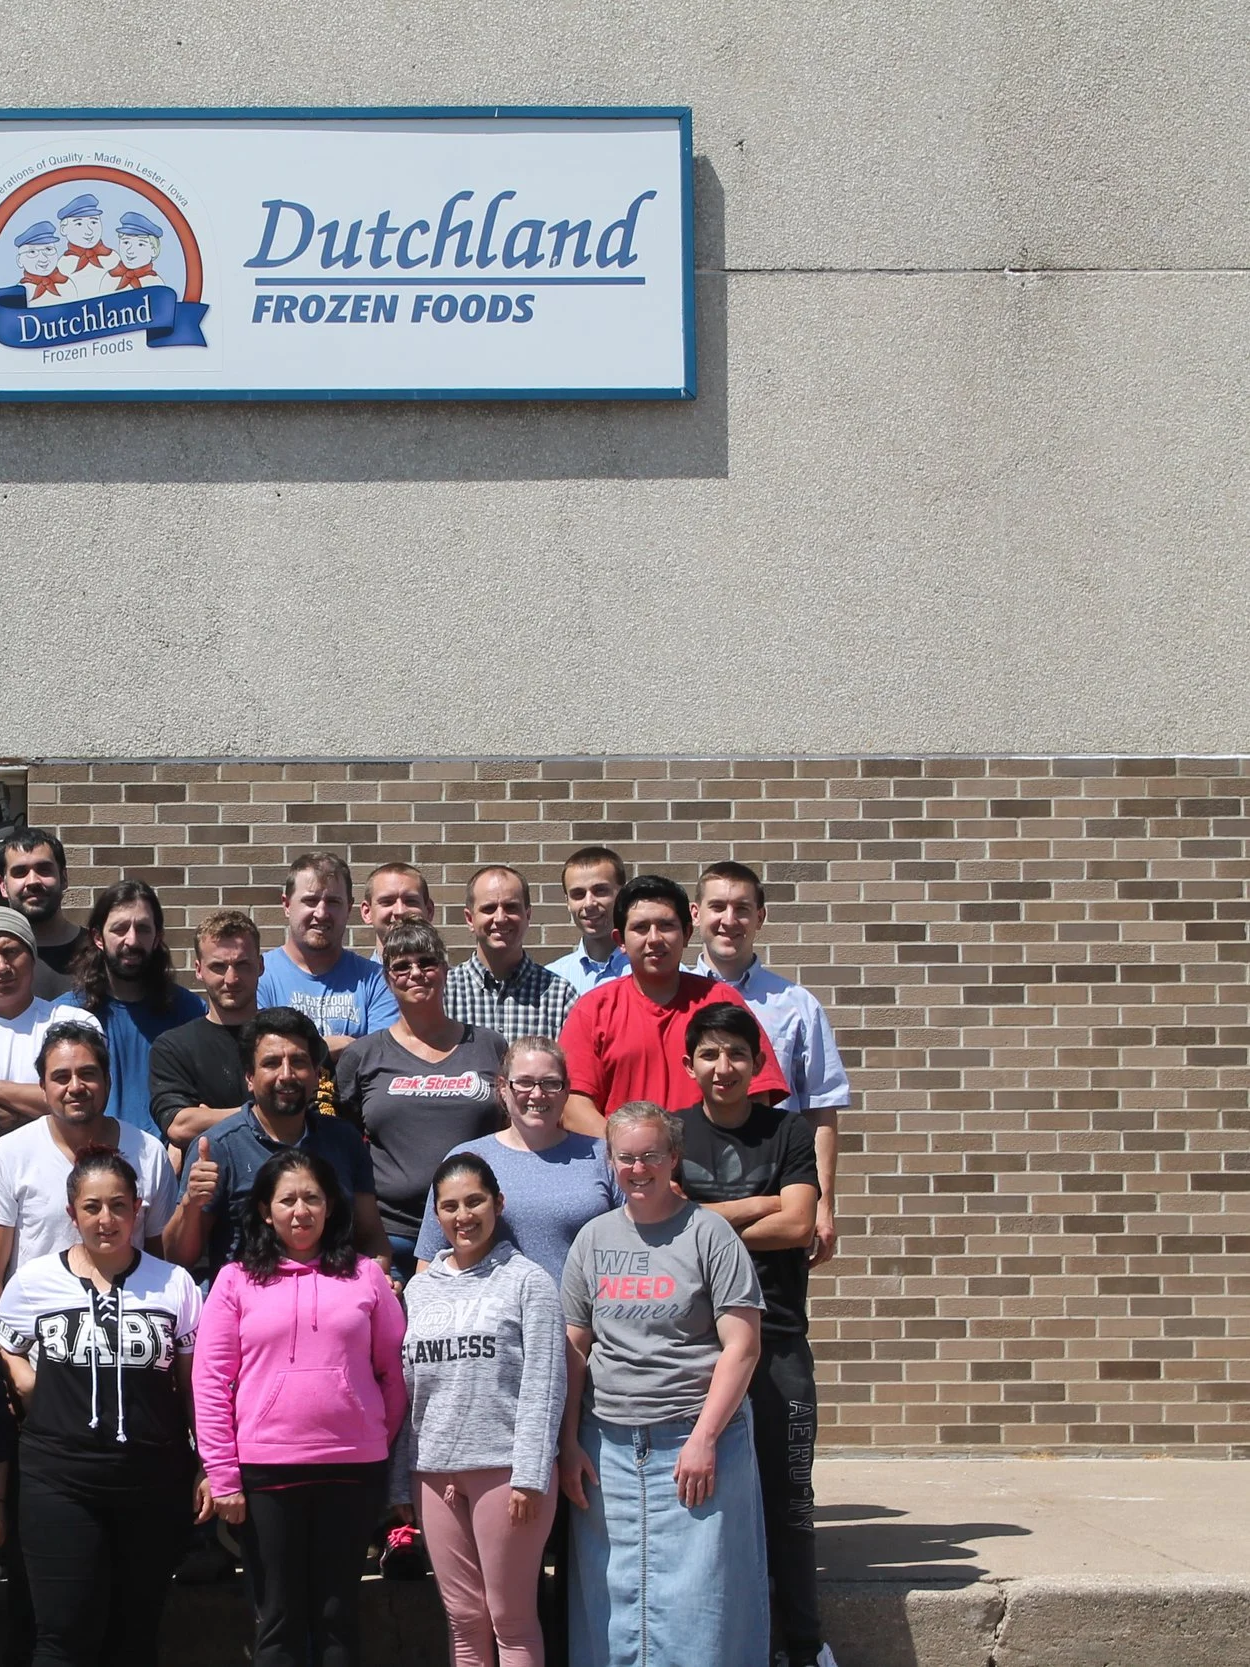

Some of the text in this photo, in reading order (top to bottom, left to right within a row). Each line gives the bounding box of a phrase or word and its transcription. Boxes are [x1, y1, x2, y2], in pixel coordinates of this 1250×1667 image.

[36, 160, 47, 171] of
[48, 152, 84, 166] Quality
[94, 152, 122, 165] Made
[124, 158, 134, 169] in
[136, 163, 166, 188] Lester,
[167, 184, 189, 207] Iowa
[243, 190, 657, 269] Dutchland
[17, 294, 152, 343] Dutchland
[252, 294, 535, 323] FROZEN FOODS
[43, 338, 134, 364] Frozen Foods
[424, 1075, 474, 1090] Street
[594, 1249, 650, 1275] WE
[597, 1275, 676, 1300] NEED
[38, 1311, 175, 1372] BABE
